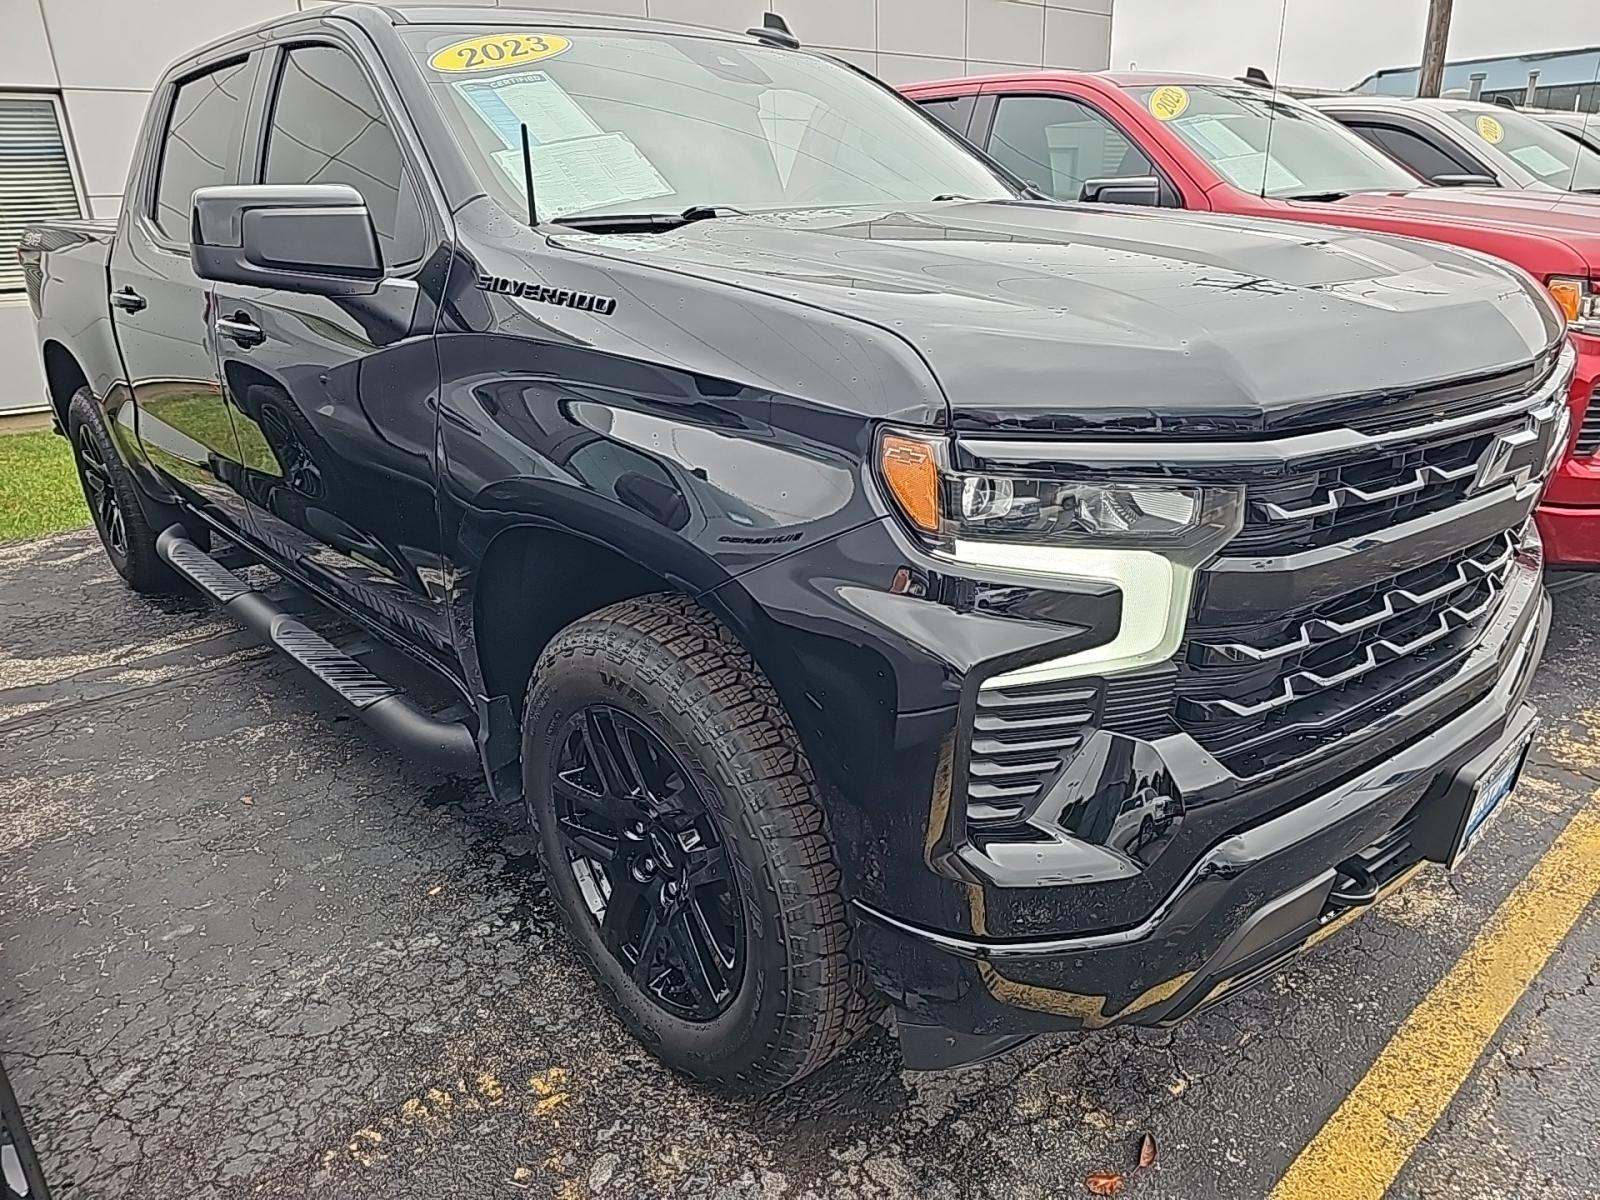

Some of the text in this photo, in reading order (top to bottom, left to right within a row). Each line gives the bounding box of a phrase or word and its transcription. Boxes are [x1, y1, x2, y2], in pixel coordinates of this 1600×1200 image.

[457, 36, 549, 67] 2023
[489, 74, 541, 89] CERTIFIED
[1156, 88, 1183, 115] 2023
[475, 274, 617, 316] SILVERADO
